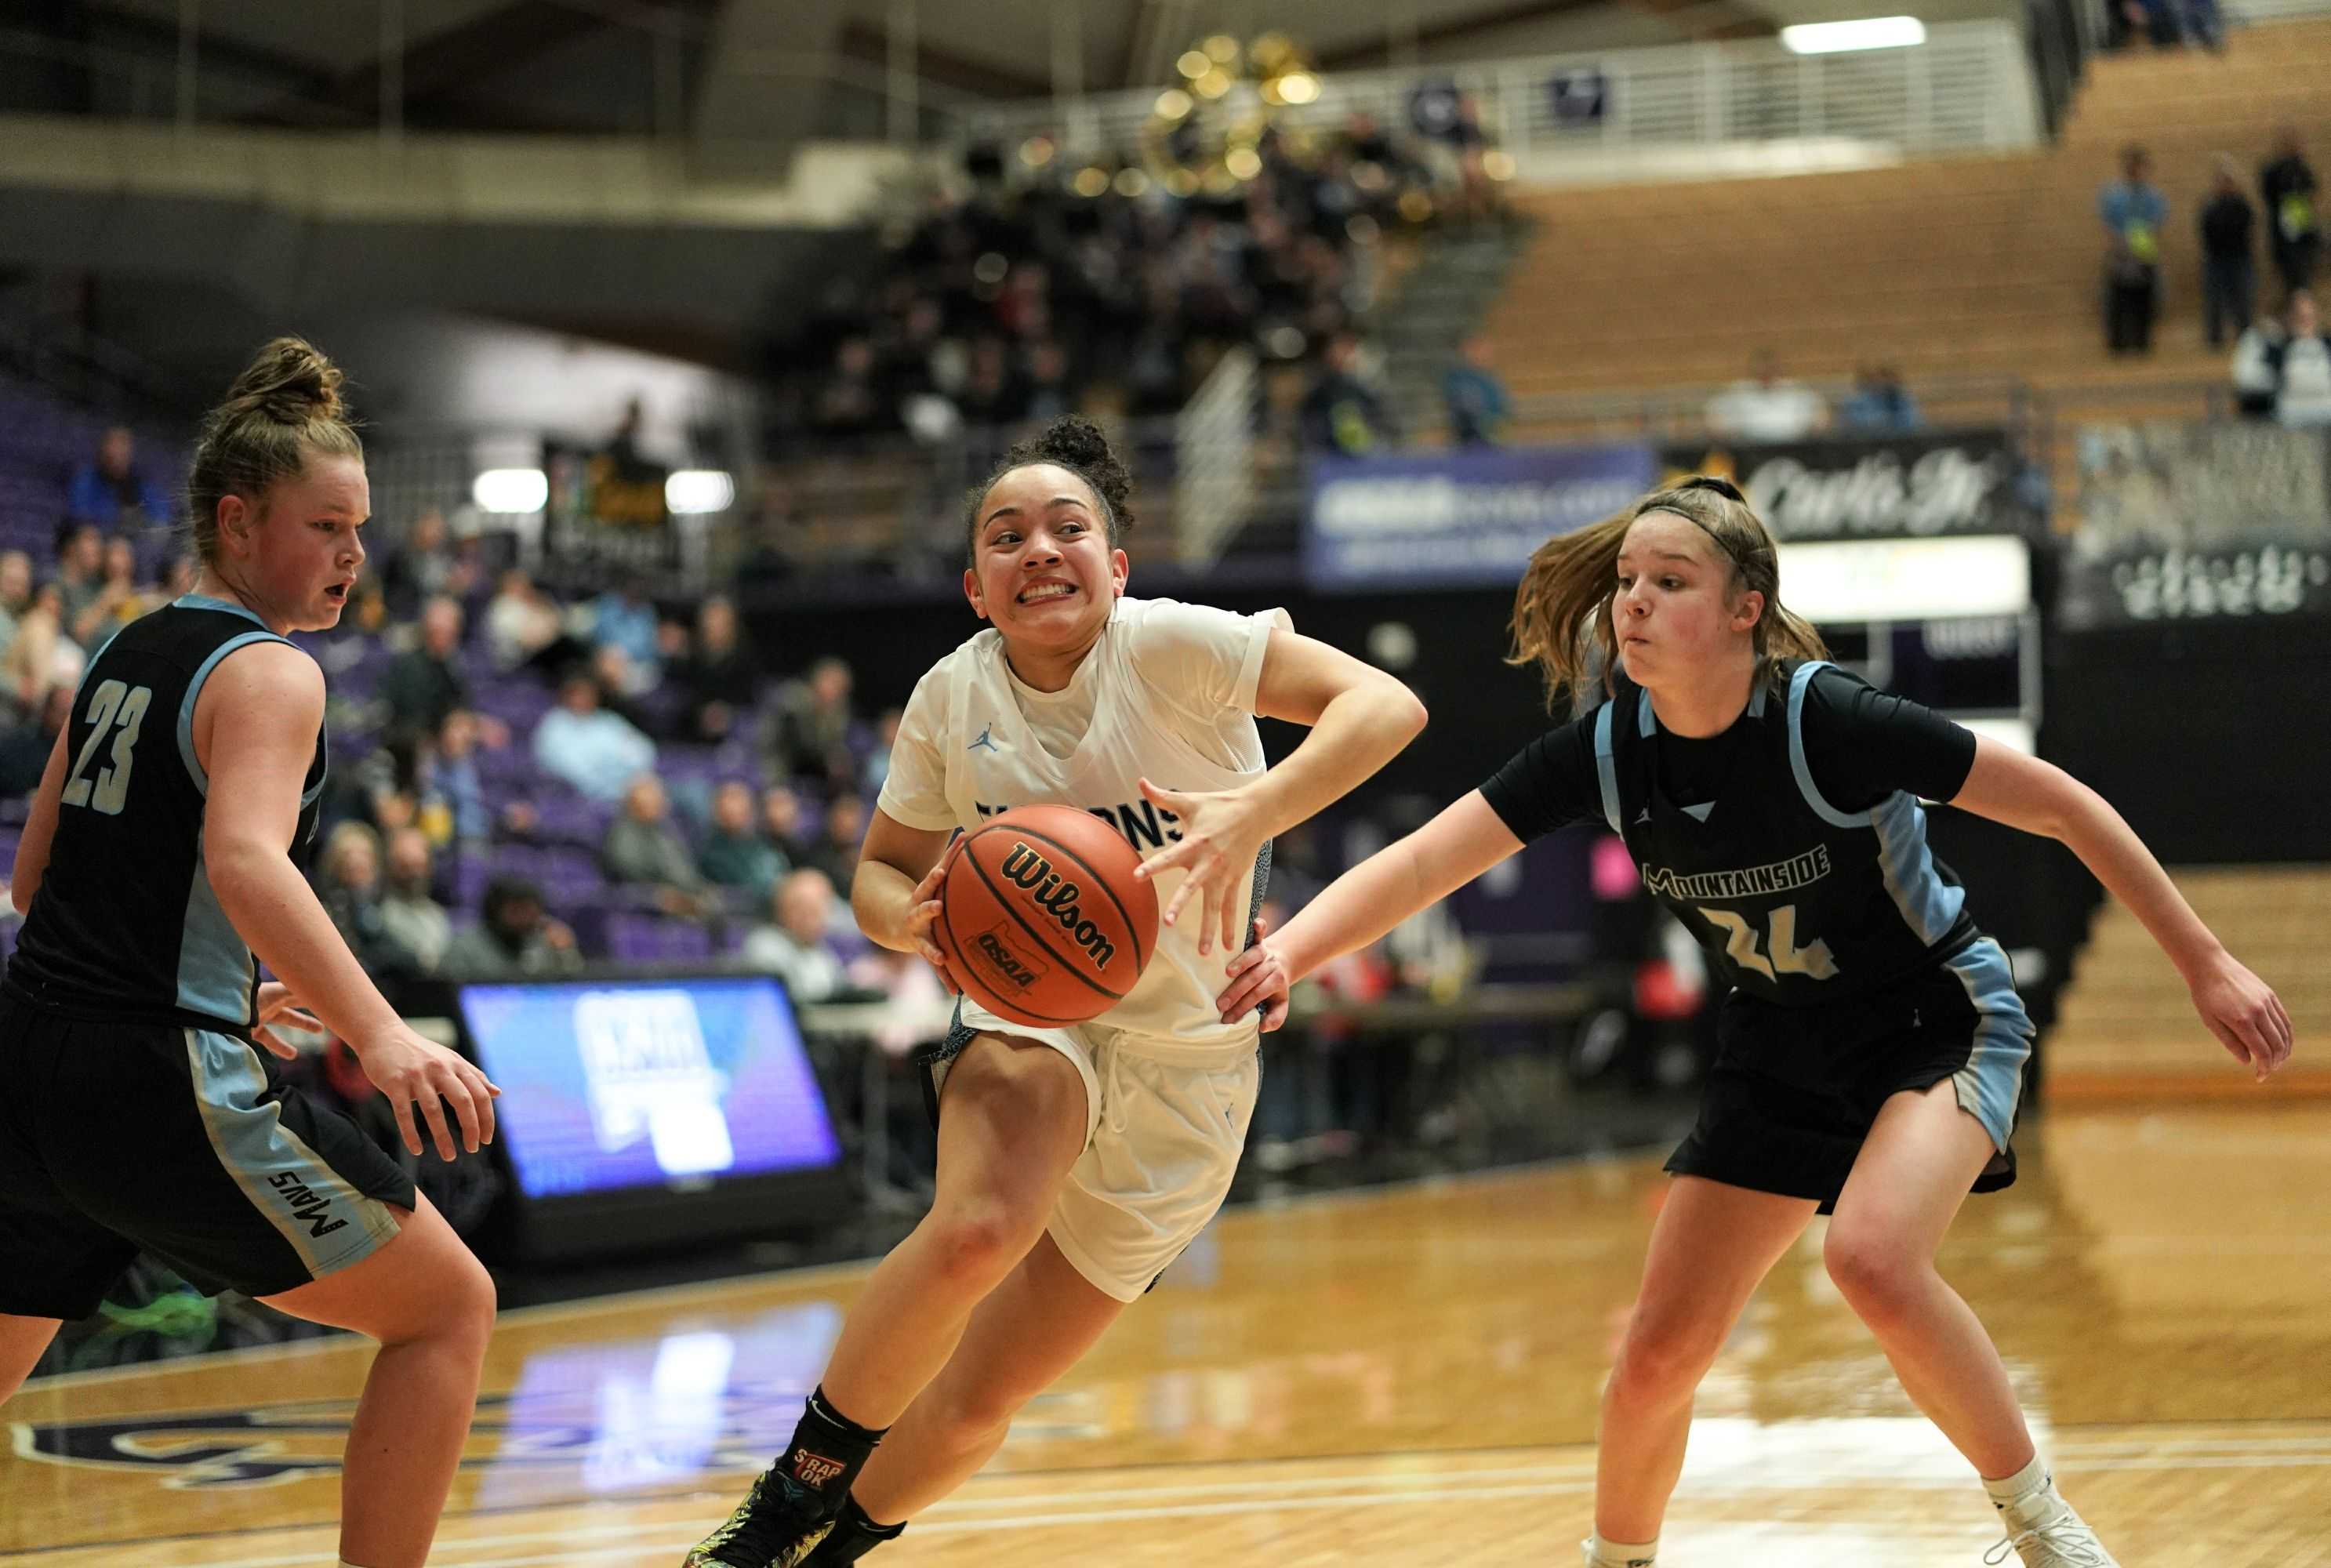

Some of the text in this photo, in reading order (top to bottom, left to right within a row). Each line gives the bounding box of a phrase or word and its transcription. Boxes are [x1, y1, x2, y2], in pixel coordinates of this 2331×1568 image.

[61, 679, 152, 815] 23
[979, 934, 1035, 986] OSAA
[1001, 841, 1116, 971] Wilson
